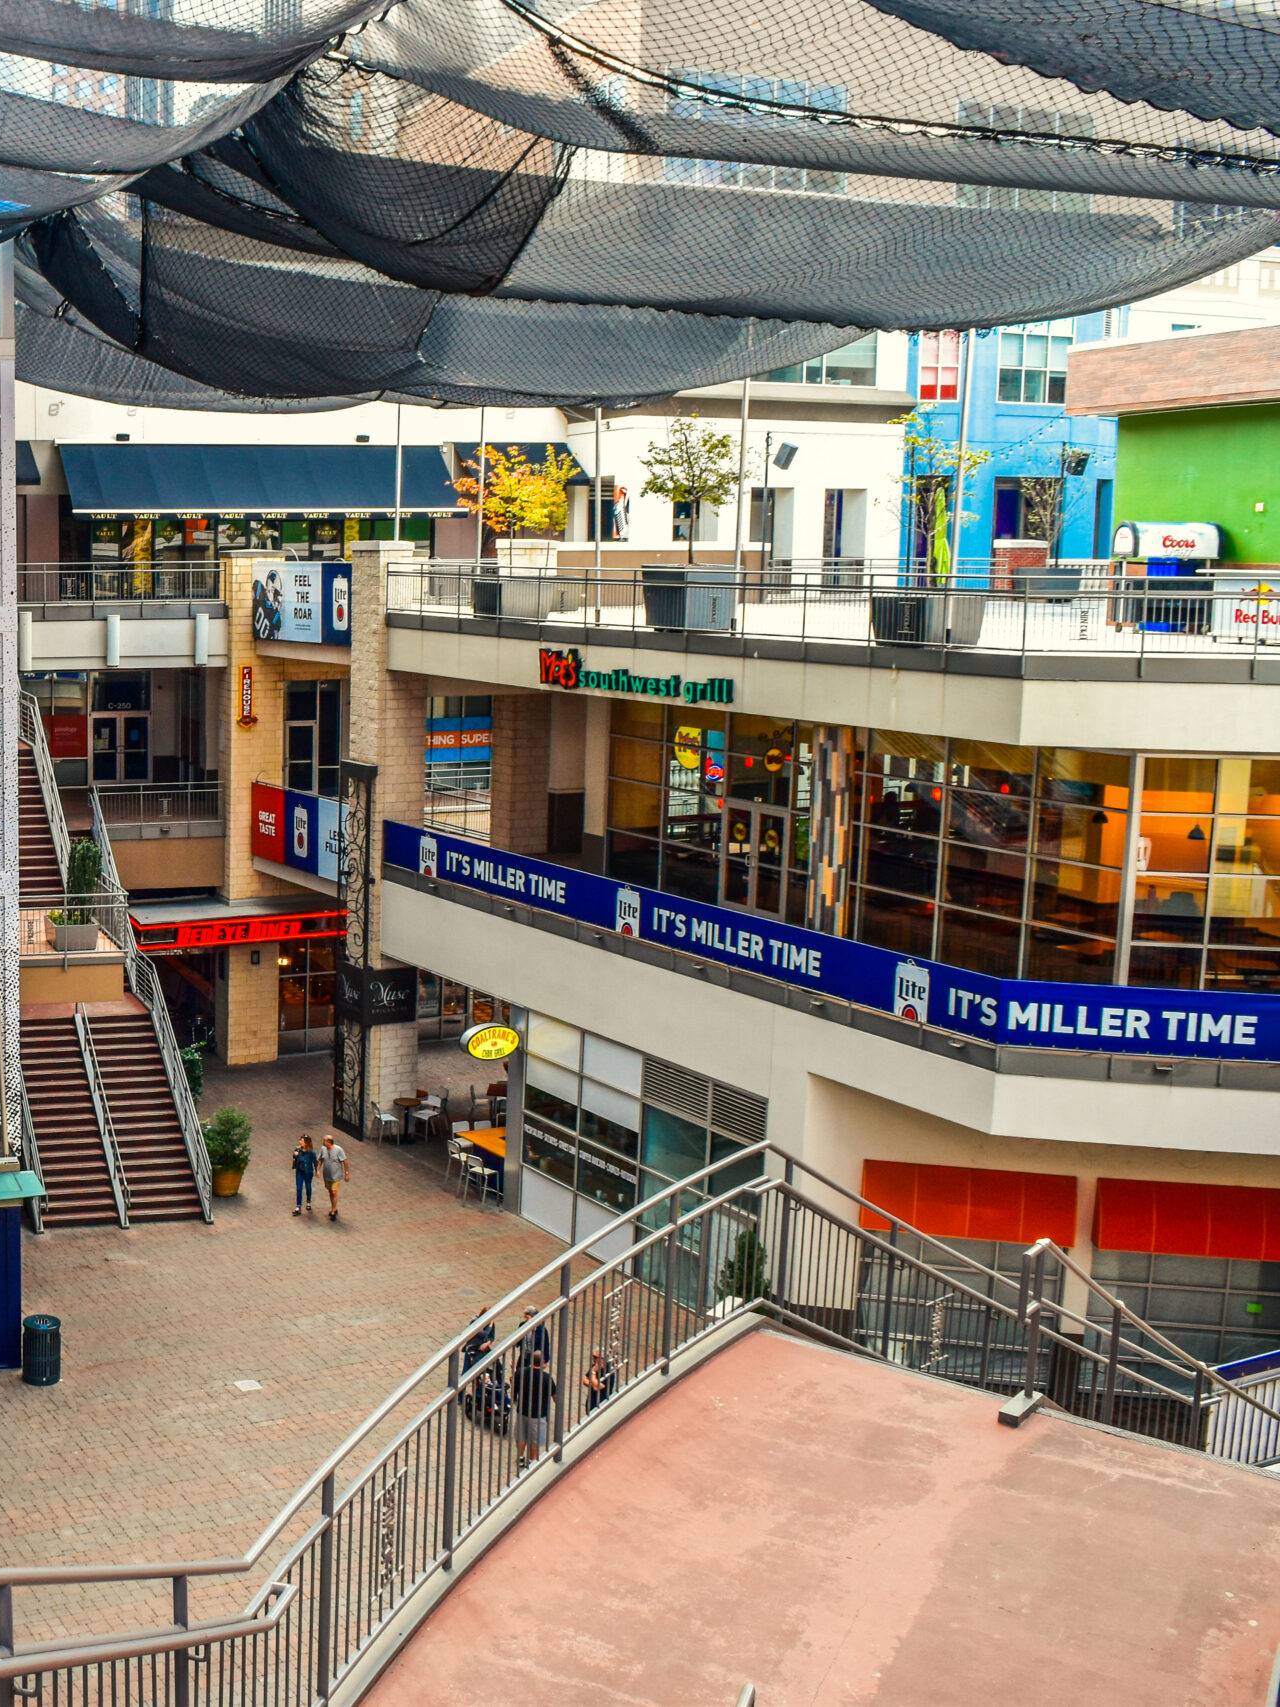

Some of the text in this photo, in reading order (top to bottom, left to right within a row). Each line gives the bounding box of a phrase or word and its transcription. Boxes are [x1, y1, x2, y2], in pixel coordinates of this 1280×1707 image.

[1162, 535, 1196, 548] Coors
[294, 575, 311, 587] FEEL
[296, 591, 309, 603] THE
[335, 588, 346, 603] Lite
[294, 608, 312, 620] ROAR
[243, 668, 251, 716] FIREHOUSE
[578, 669, 680, 697] southwest
[683, 678, 732, 704] grill
[258, 810, 276, 824] GREAT
[295, 815, 307, 831] Lite
[258, 822, 276, 837] TASTE
[421, 846, 435, 863] Lite
[446, 850, 566, 904] IT'S MILLER TIME
[618, 900, 638, 922] Lite
[653, 907, 822, 978] IT'S MILLER TIME
[897, 976, 926, 1002] Lite
[948, 987, 1258, 1045] IT'S MILLER TIME
